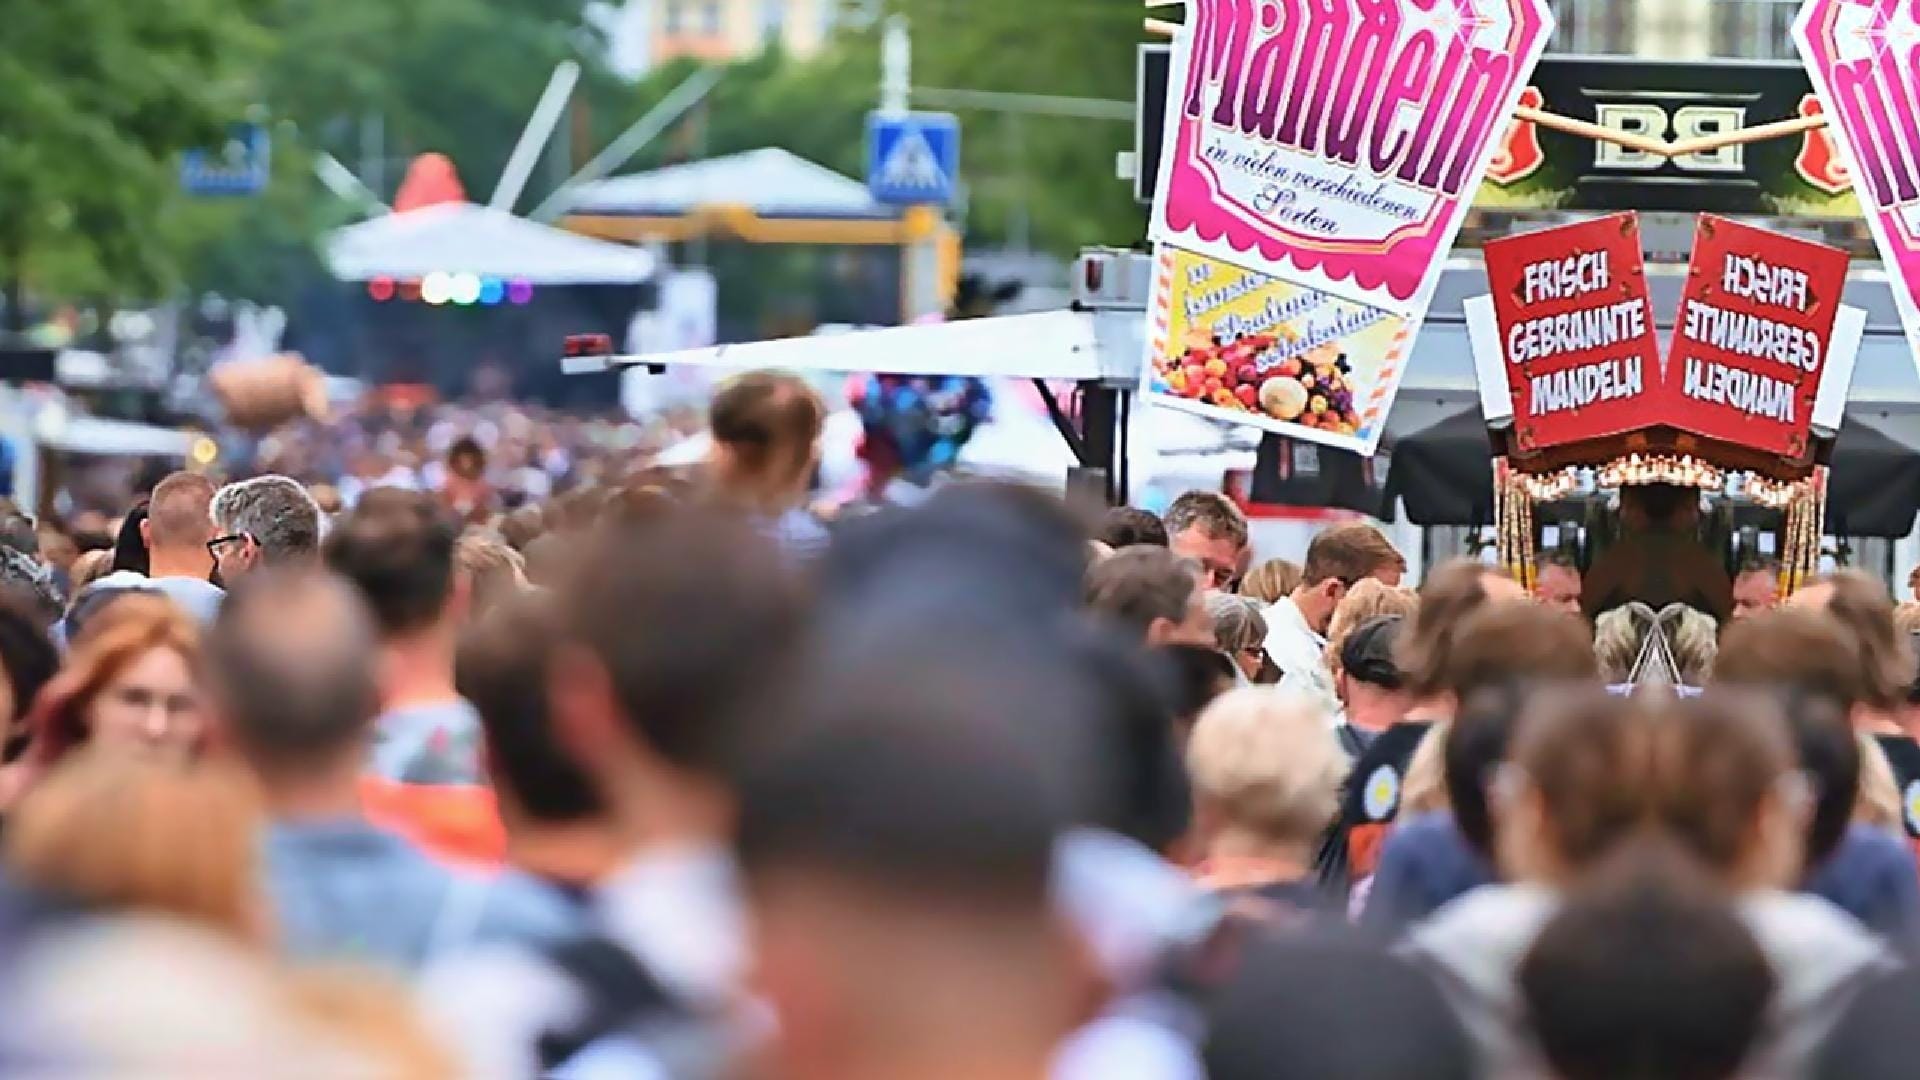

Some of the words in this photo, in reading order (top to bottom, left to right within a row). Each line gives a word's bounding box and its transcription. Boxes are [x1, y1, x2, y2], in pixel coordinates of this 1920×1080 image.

[1205, 137, 1228, 162] in
[1232, 149, 1289, 182] vielen
[1292, 173, 1419, 219] verschiedenen
[1252, 182, 1340, 234] Sorten
[1523, 250, 1610, 304] FRISCH
[1508, 299, 1646, 364] GEBRANNTE
[1528, 356, 1643, 416] MANDELN
